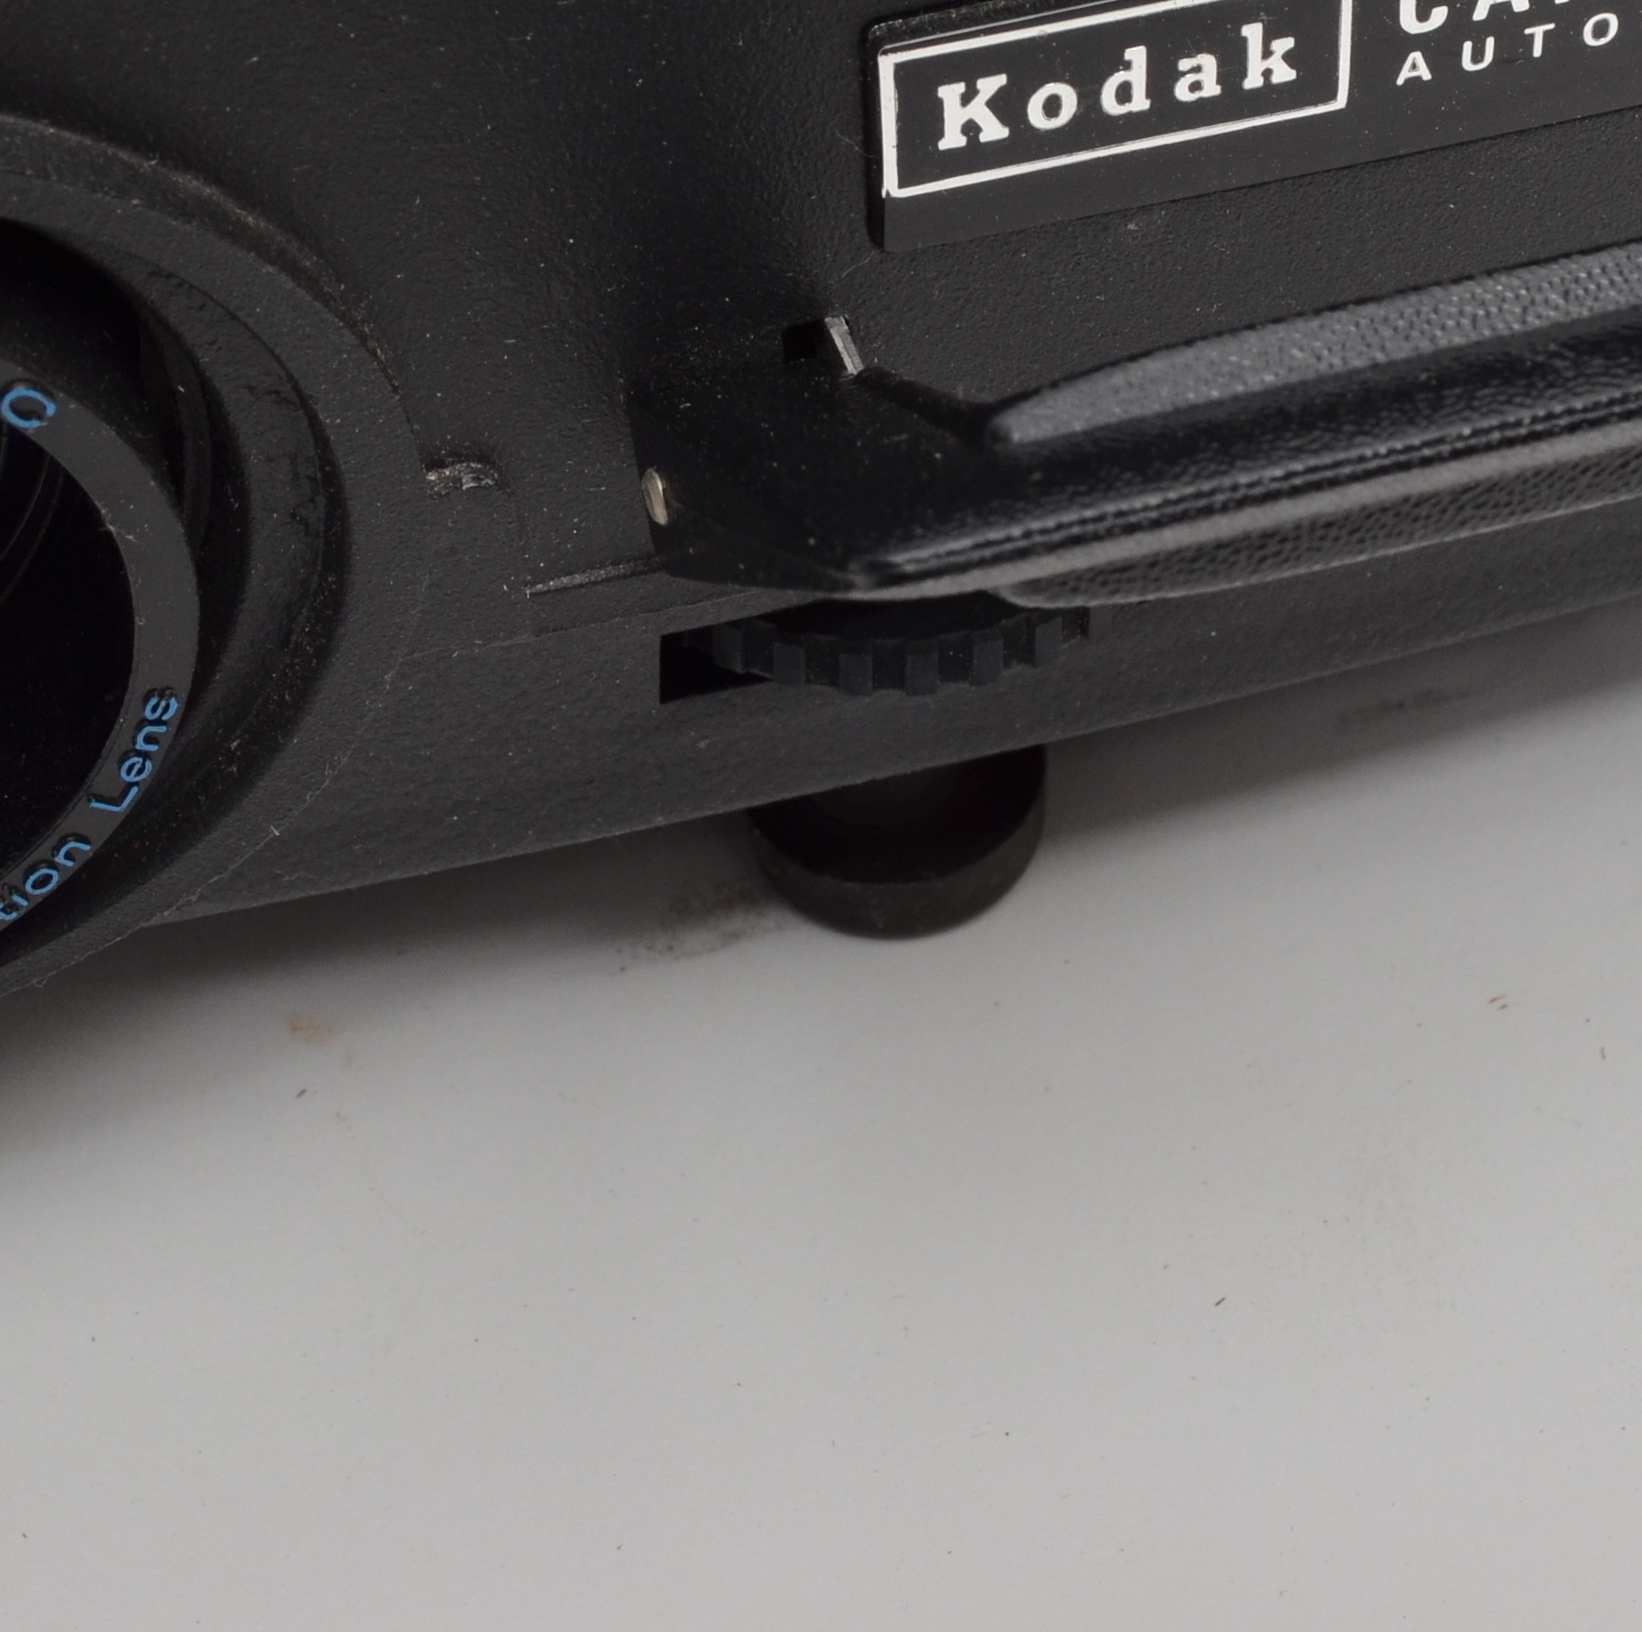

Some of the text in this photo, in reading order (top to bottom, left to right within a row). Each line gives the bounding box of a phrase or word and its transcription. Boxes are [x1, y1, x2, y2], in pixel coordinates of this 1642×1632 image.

[936, 21, 1298, 152] Kodak
[0, 386, 58, 432] C
[88, 693, 180, 815] Lens
